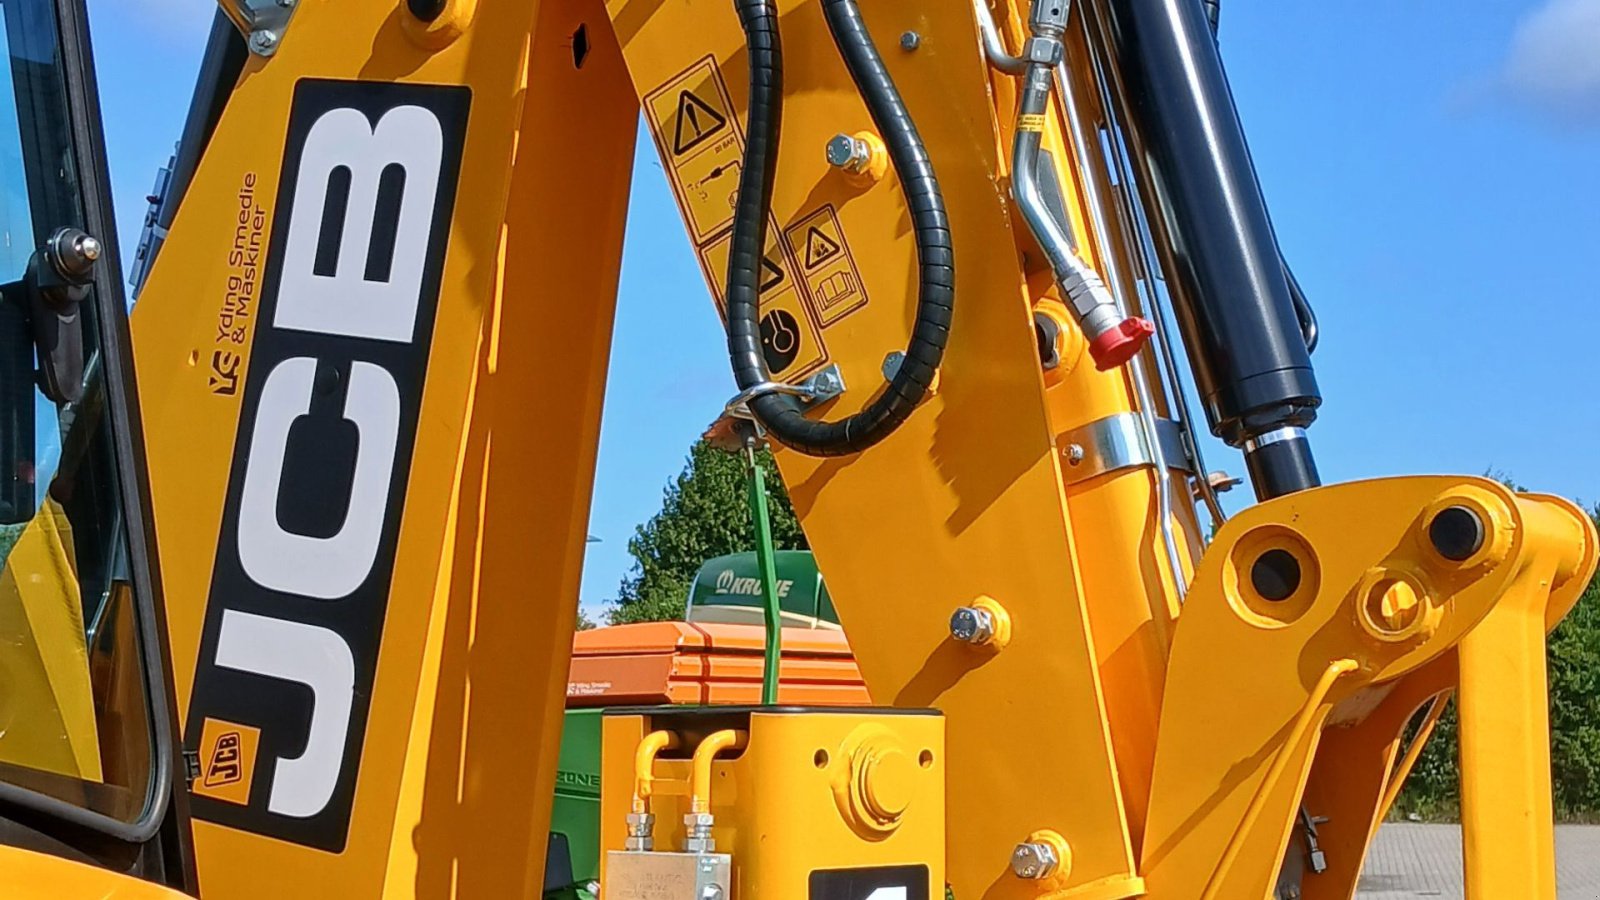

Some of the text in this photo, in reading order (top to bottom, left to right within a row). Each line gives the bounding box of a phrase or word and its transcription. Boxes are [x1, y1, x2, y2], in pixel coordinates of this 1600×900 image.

[216, 173, 256, 343] Yding Smedie
[231, 204, 265, 344] & Maskiner
[214, 105, 444, 818] JCB
[210, 735, 238, 782] JCB
